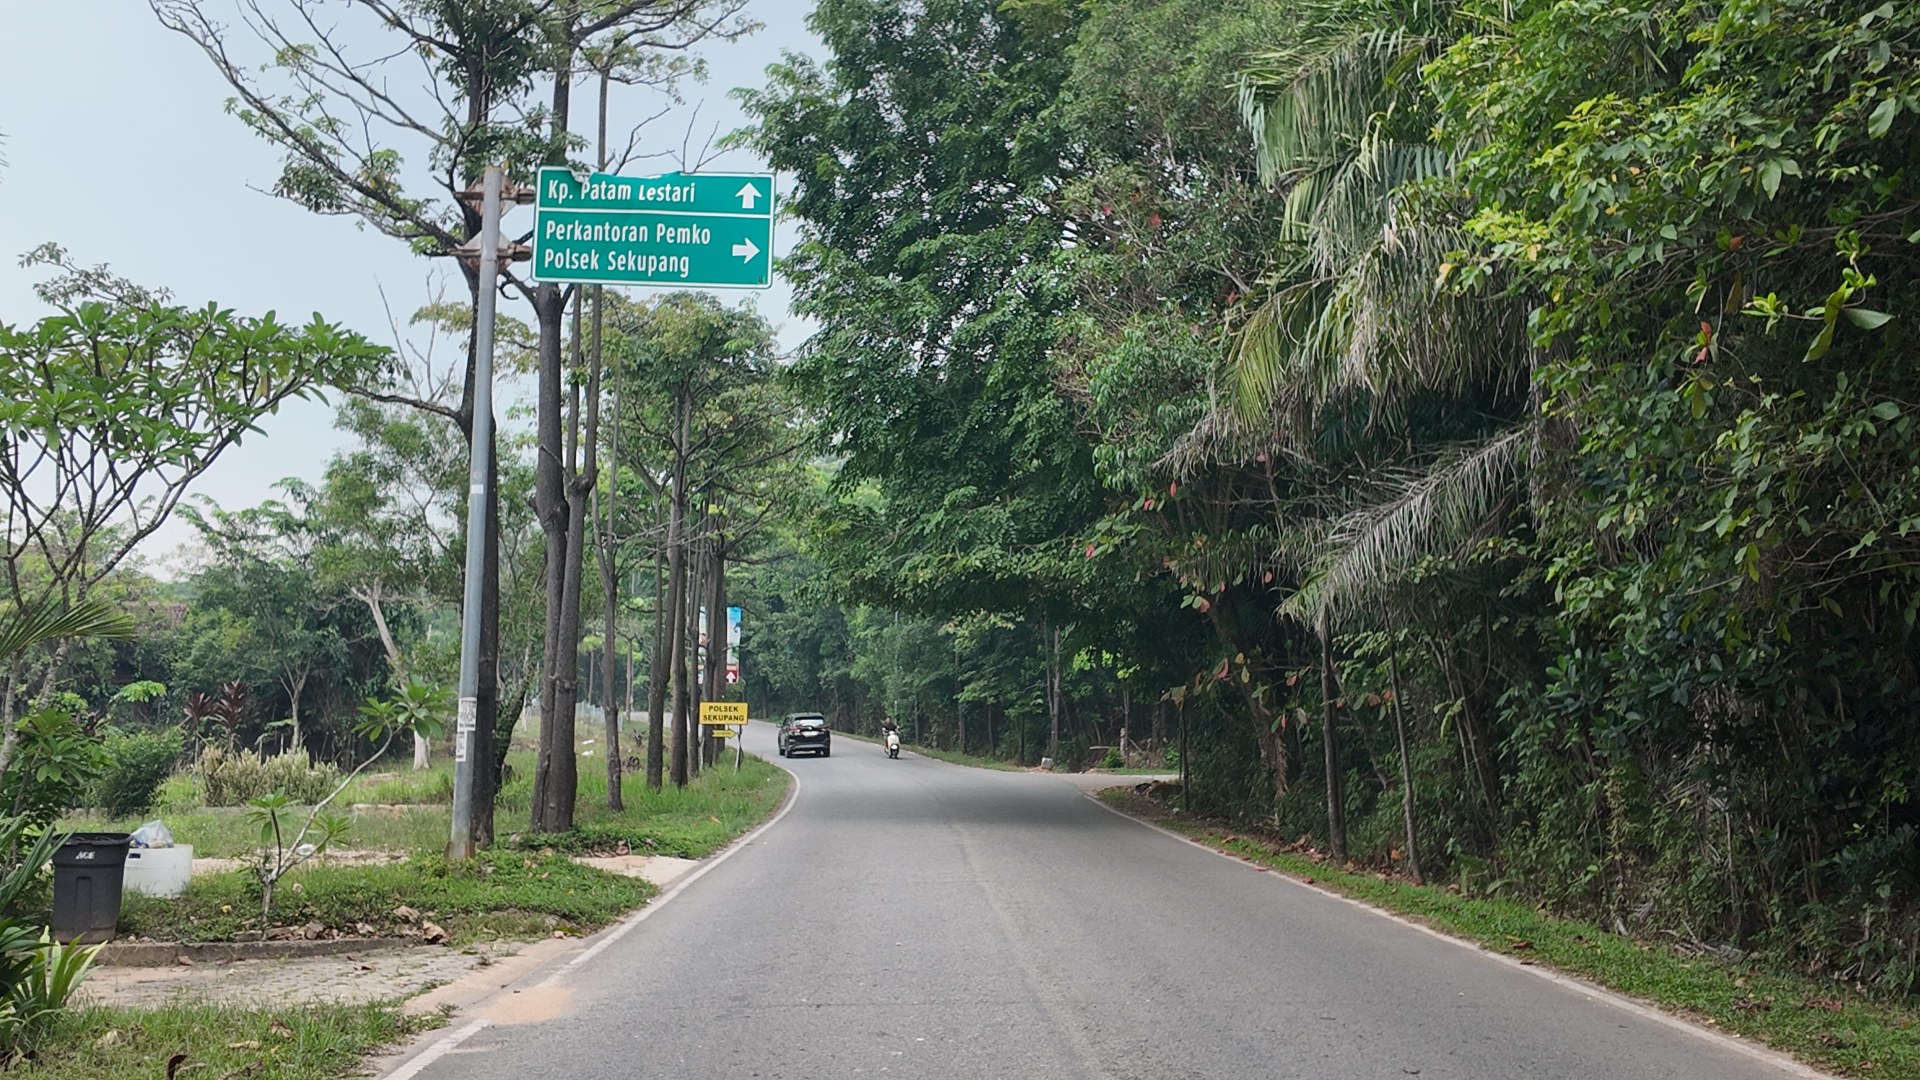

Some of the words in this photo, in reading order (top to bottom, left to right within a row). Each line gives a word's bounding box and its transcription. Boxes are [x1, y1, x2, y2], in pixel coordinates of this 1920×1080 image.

[548, 179, 573, 204] Kp.
[581, 180, 631, 201] Patam
[638, 182, 696, 203] Lestari
[545, 220, 648, 242] Perkantoran
[656, 223, 711, 245] Pemko
[544, 248, 600, 270] Polsek
[607, 250, 690, 278] Sekupang
[75, 851, 95, 860] ACE
